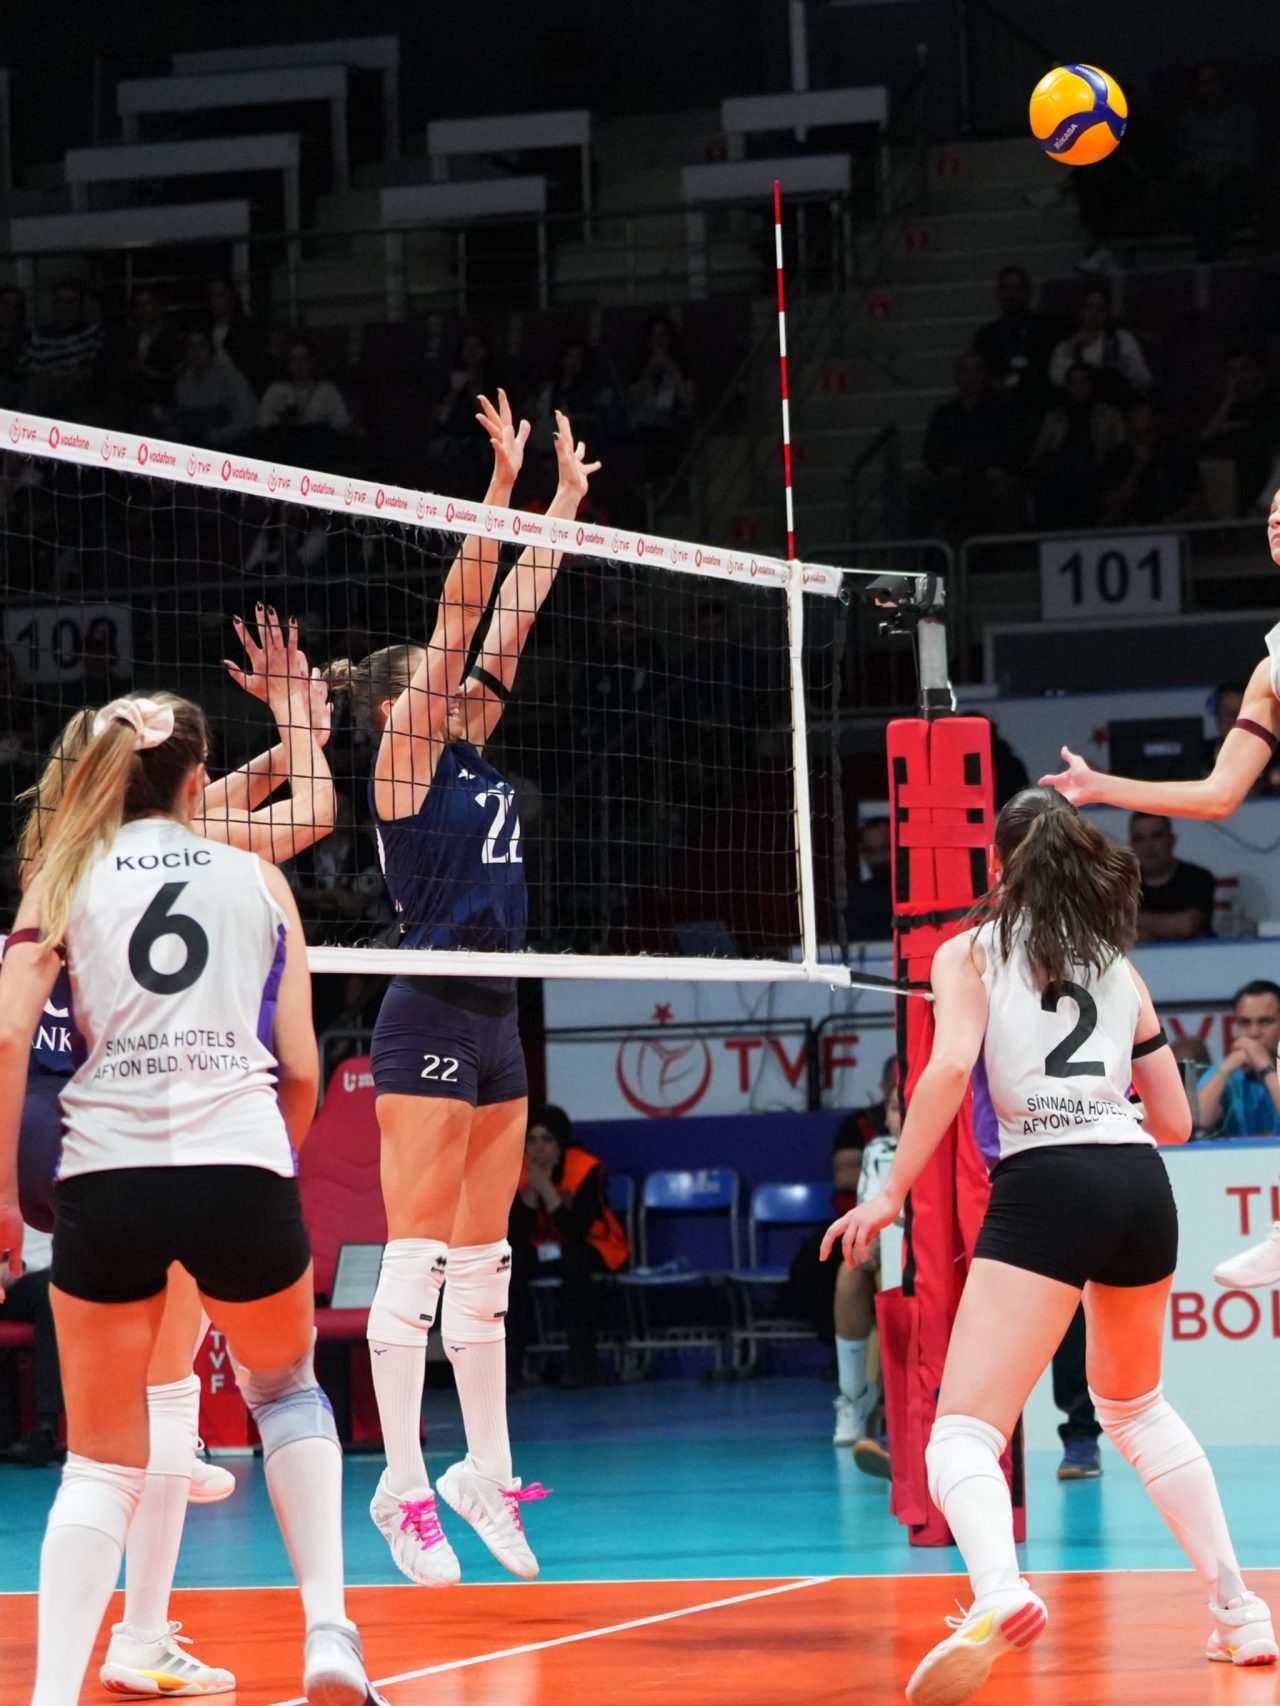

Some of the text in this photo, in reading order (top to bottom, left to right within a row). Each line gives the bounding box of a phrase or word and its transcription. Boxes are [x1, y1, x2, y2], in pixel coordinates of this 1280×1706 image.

[1054, 123, 1078, 150] MIKASA
[22, 428, 37, 442] TVF
[61, 435, 90, 450] vodafone
[113, 445, 127, 459] TVF
[150, 451, 177, 466] vodafone
[198, 461, 212, 474] TVF
[232, 467, 258, 482] vodafone
[278, 478, 291, 489] TVF
[310, 482, 335, 496] vodafone
[354, 491, 367, 503] TVF
[384, 496, 408, 510] vodafone
[426, 505, 438, 516] TVF
[454, 509, 477, 522] vodafone
[494, 517, 505, 528] TVF
[521, 522, 542, 534] vodafone
[558, 529, 569, 540] TVF
[584, 533, 605, 545] vodafone
[619, 540, 630, 550] TVF
[644, 544, 664, 556] vodafone
[1058, 549, 1162, 605] 101
[128, 881, 209, 995] 6
[32, 1025, 73, 1052] NK
[175, 1029, 235, 1048] HOTELS
[1041, 980, 1106, 1078] 2
[93, 1060, 142, 1081] AFYON
[147, 1056, 183, 1074] BLD.
[421, 1054, 460, 1083] 22
[724, 1035, 860, 1094] TVF
[1026, 1094, 1127, 1116] SİNNADA HOTE
[1023, 1114, 1070, 1135] AFYON
[209, 1330, 226, 1394] TVF
